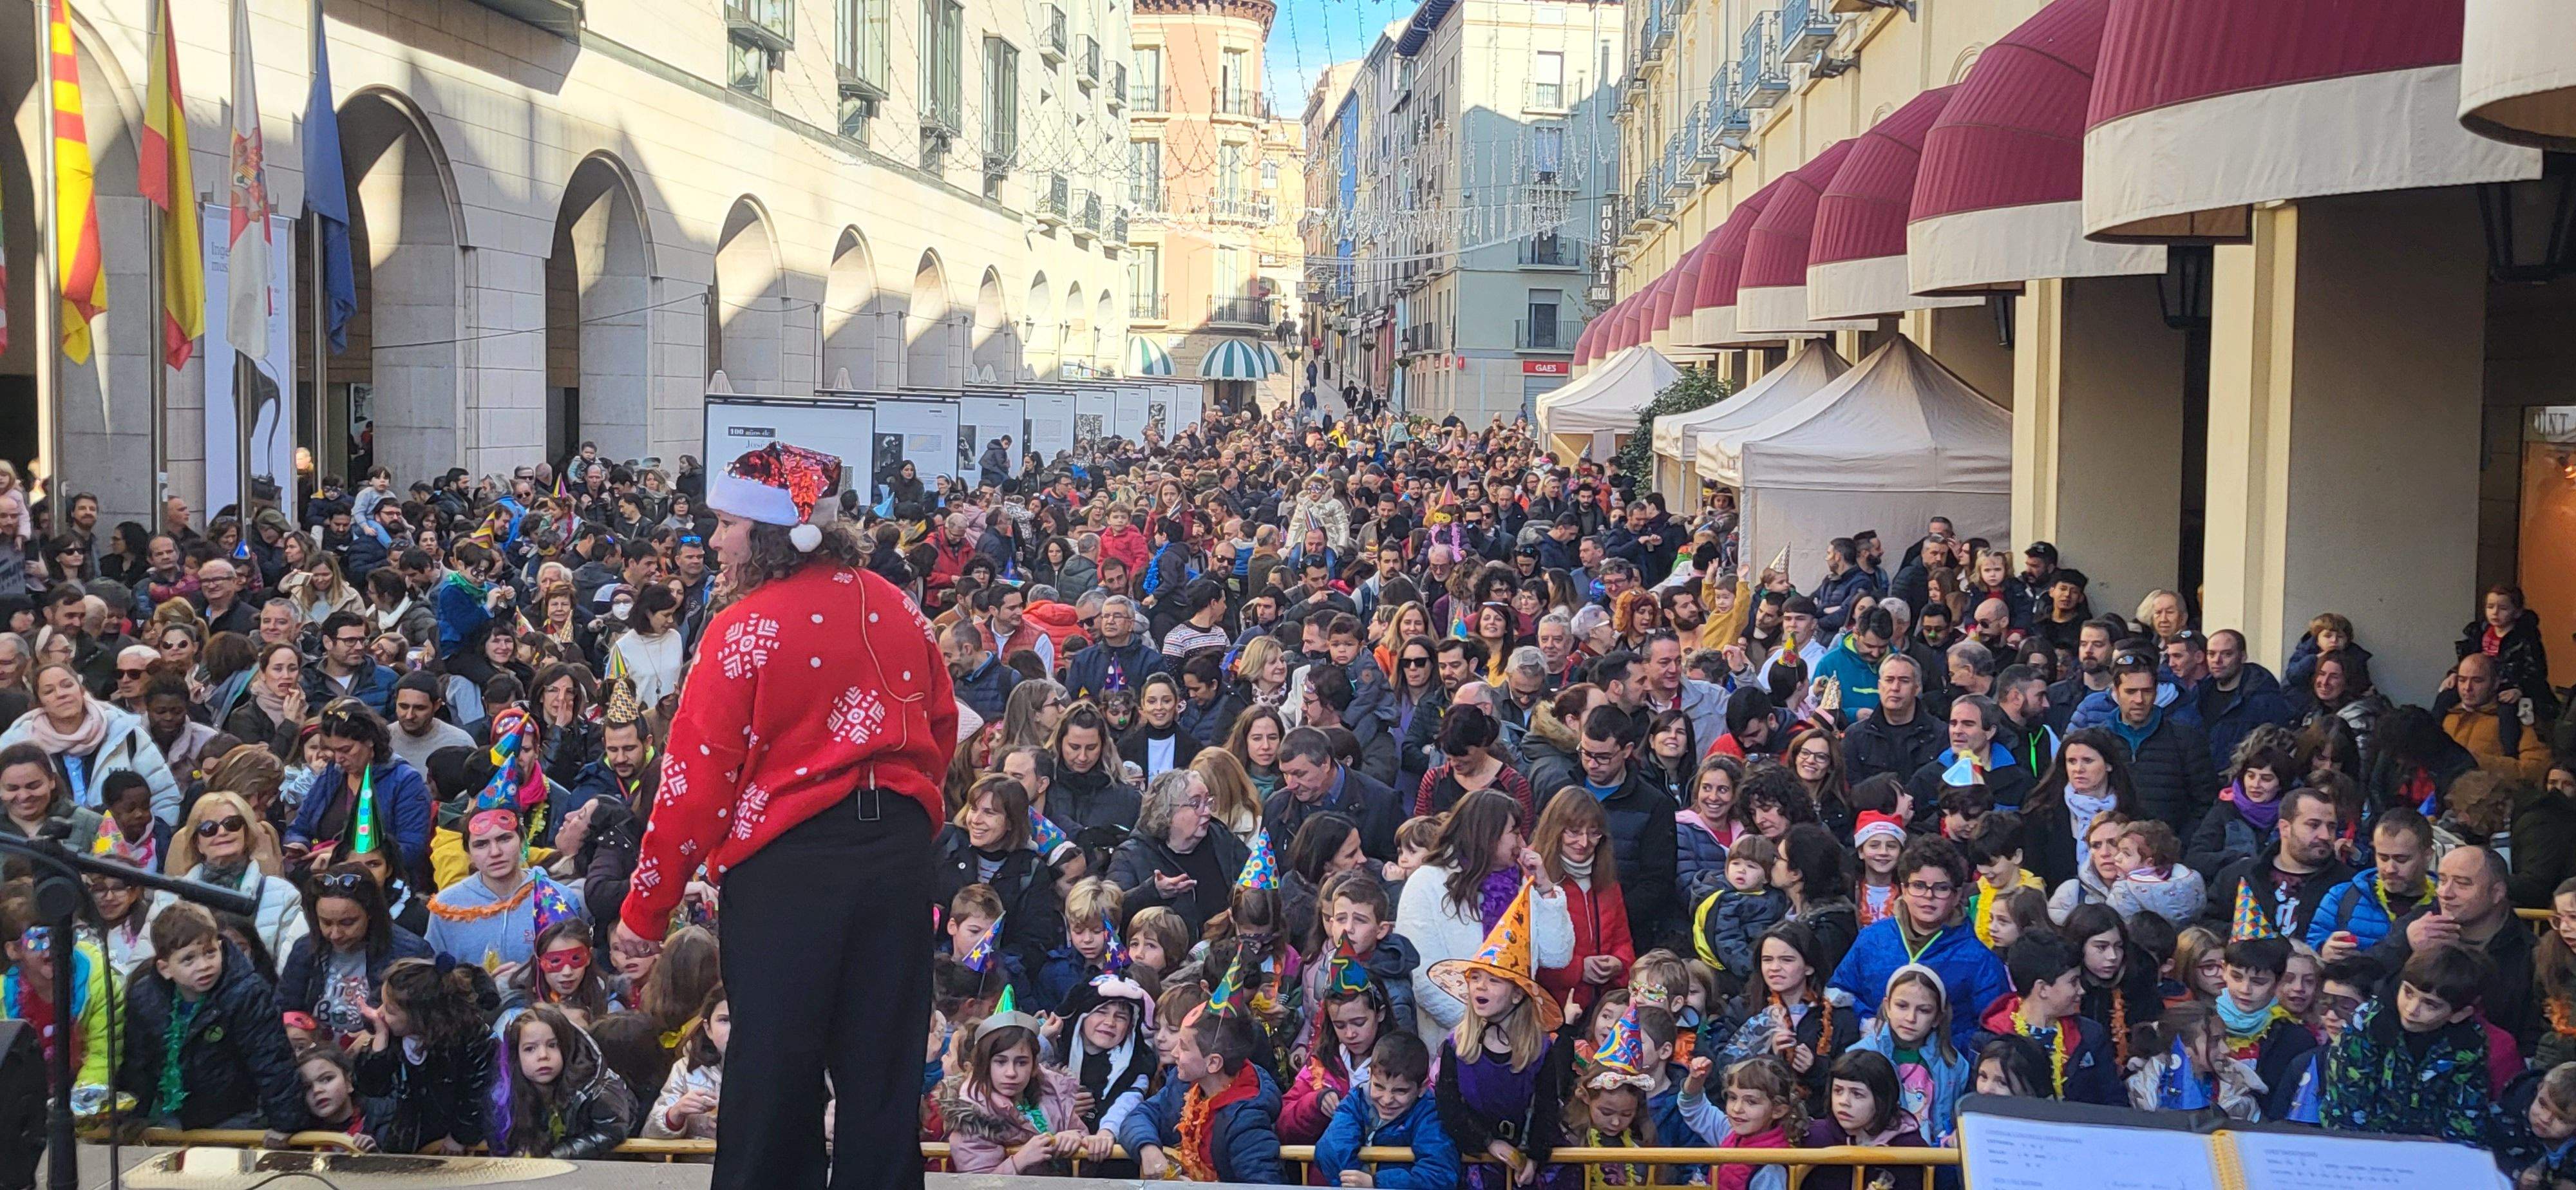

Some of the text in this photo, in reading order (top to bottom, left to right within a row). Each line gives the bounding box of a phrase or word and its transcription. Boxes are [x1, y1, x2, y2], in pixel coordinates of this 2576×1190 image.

[211, 241, 231, 259] Inge
[1599, 205, 1612, 284] HOSTAL
[1535, 364, 1557, 372] GAES
